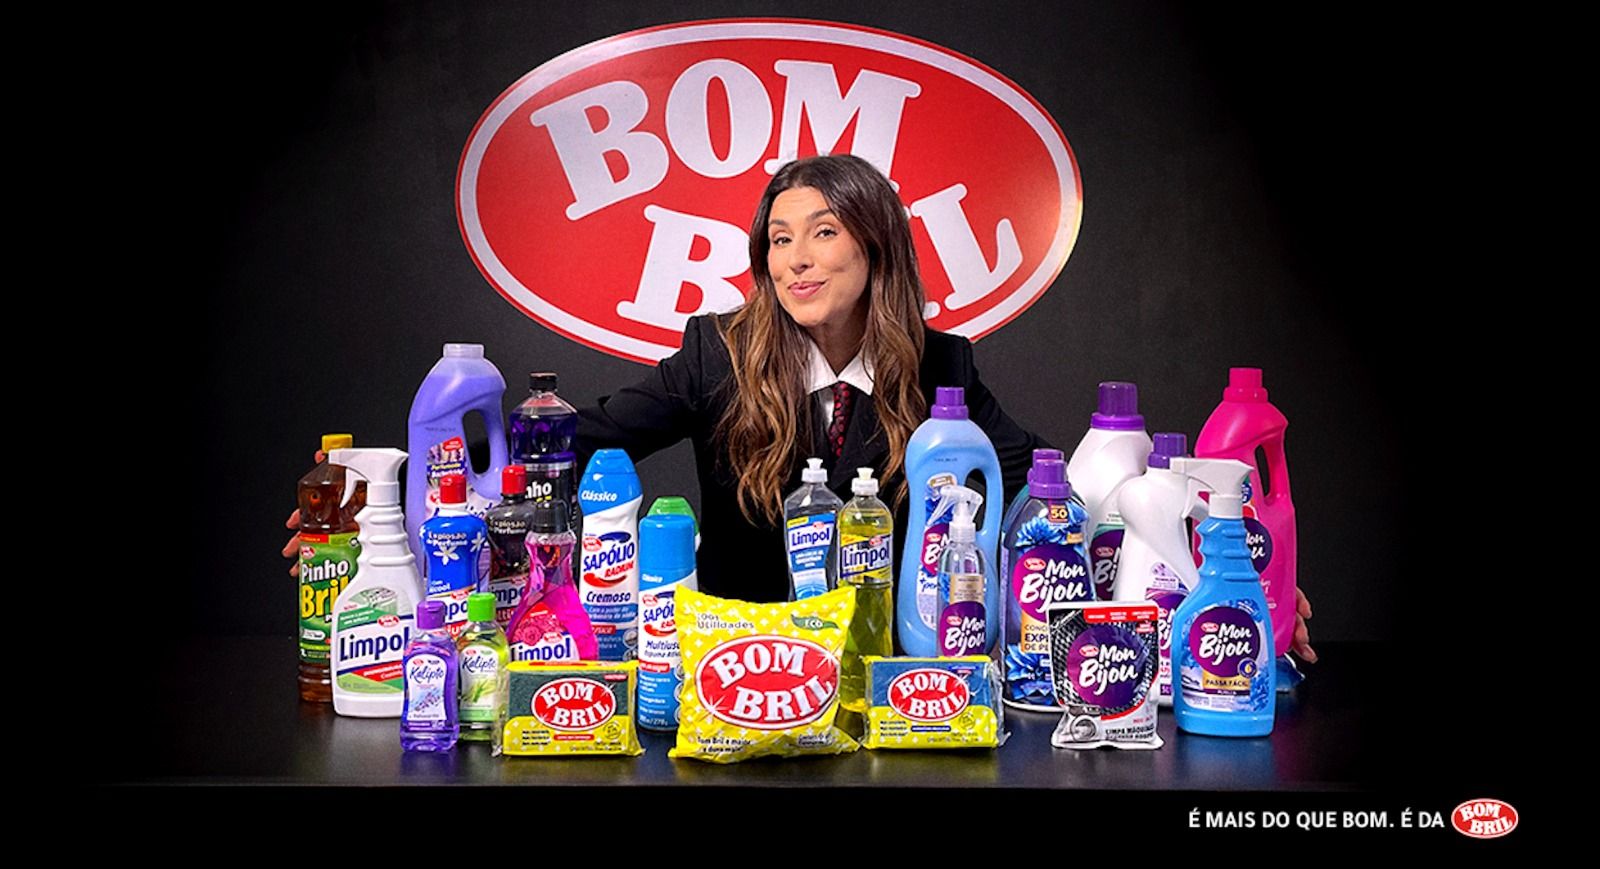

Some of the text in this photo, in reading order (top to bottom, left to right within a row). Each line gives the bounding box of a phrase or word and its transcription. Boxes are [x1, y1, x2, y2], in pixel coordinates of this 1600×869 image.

[530, 58, 921, 221] BOM
[616, 183, 1024, 327] BL
[1050, 508, 1068, 519] 50
[792, 527, 830, 546] Limpol
[583, 542, 635, 571] SAPÓLIO
[842, 540, 890, 568] Limpol
[301, 559, 350, 583] Pinho
[1045, 558, 1086, 580] Mon
[586, 591, 631, 603] Cremoso
[1019, 572, 1088, 613] Bijou
[340, 626, 410, 662] Limpol
[1219, 623, 1252, 640] Mon
[1099, 644, 1137, 662] Mon
[1199, 634, 1253, 666] Bijou
[709, 642, 809, 690] BOM
[1078, 658, 1139, 696] Bijou
[541, 682, 596, 709] BOM
[729, 676, 833, 722] BRIL
[895, 673, 950, 699] BOM
[551, 701, 611, 727] BRIL
[908, 692, 965, 718] BRIL
